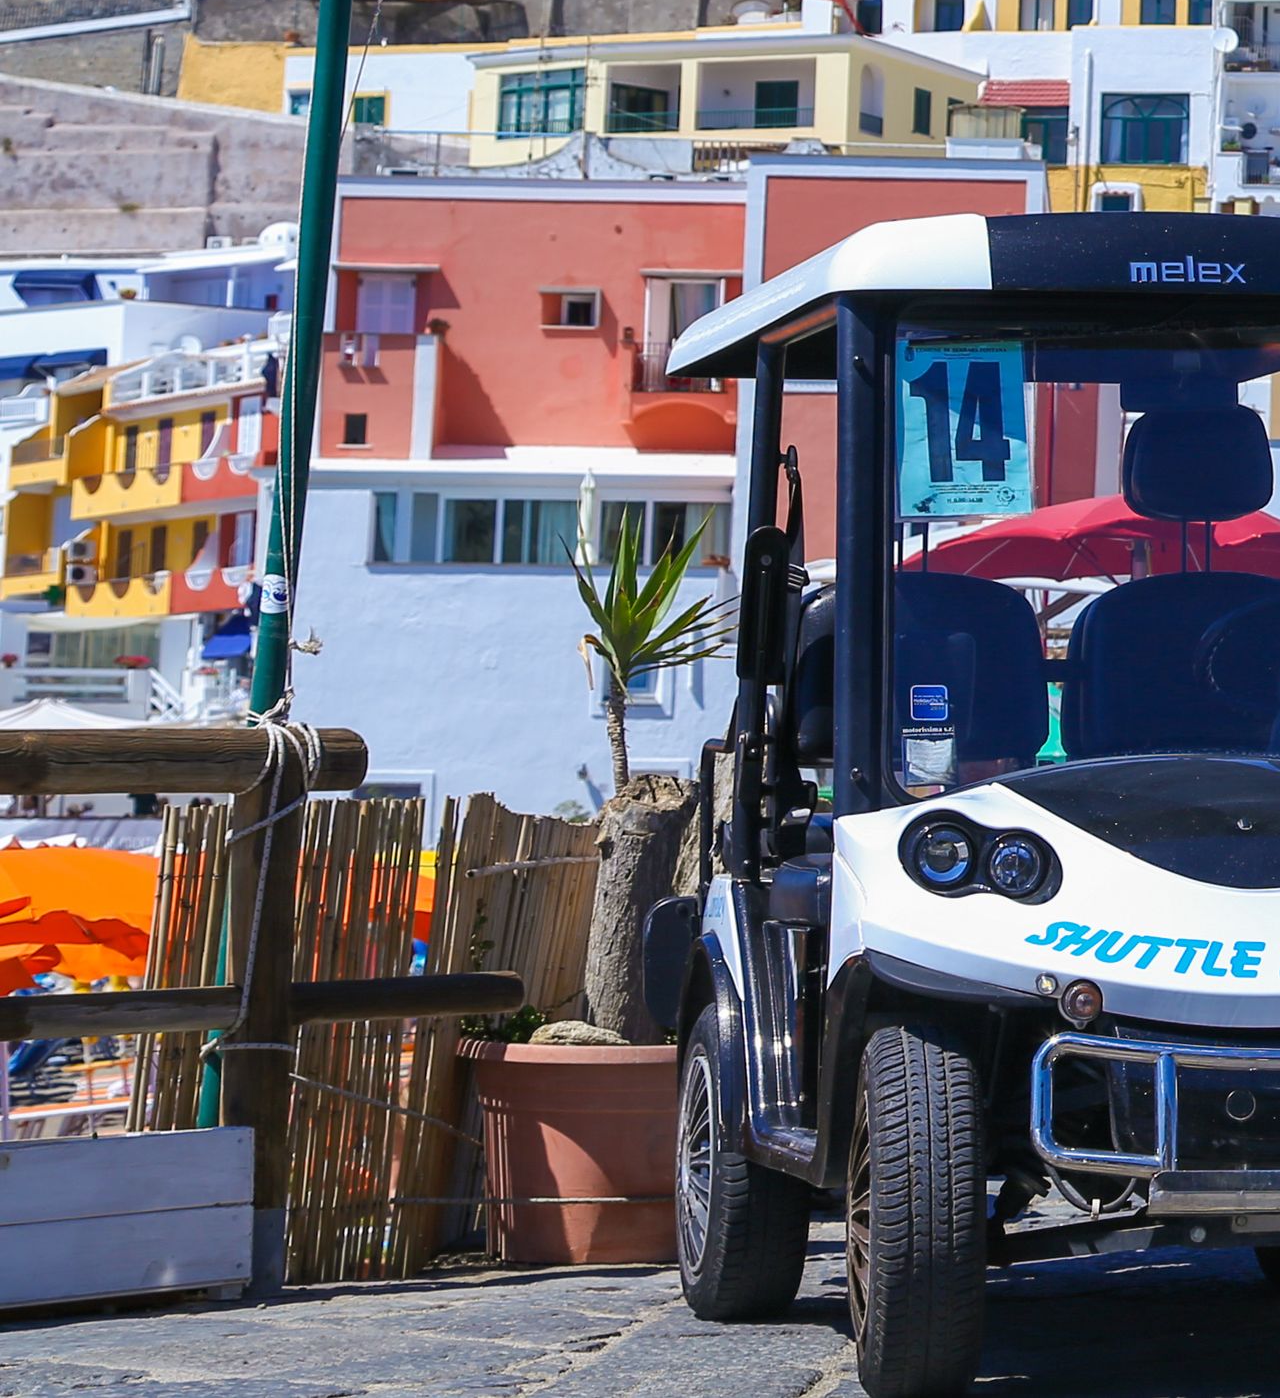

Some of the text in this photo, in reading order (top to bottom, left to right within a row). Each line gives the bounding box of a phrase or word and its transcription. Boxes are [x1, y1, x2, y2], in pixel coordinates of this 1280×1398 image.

[1129, 255, 1246, 283] melex
[909, 361, 1011, 482] 14
[1024, 920, 1267, 979] SHUTTLE
